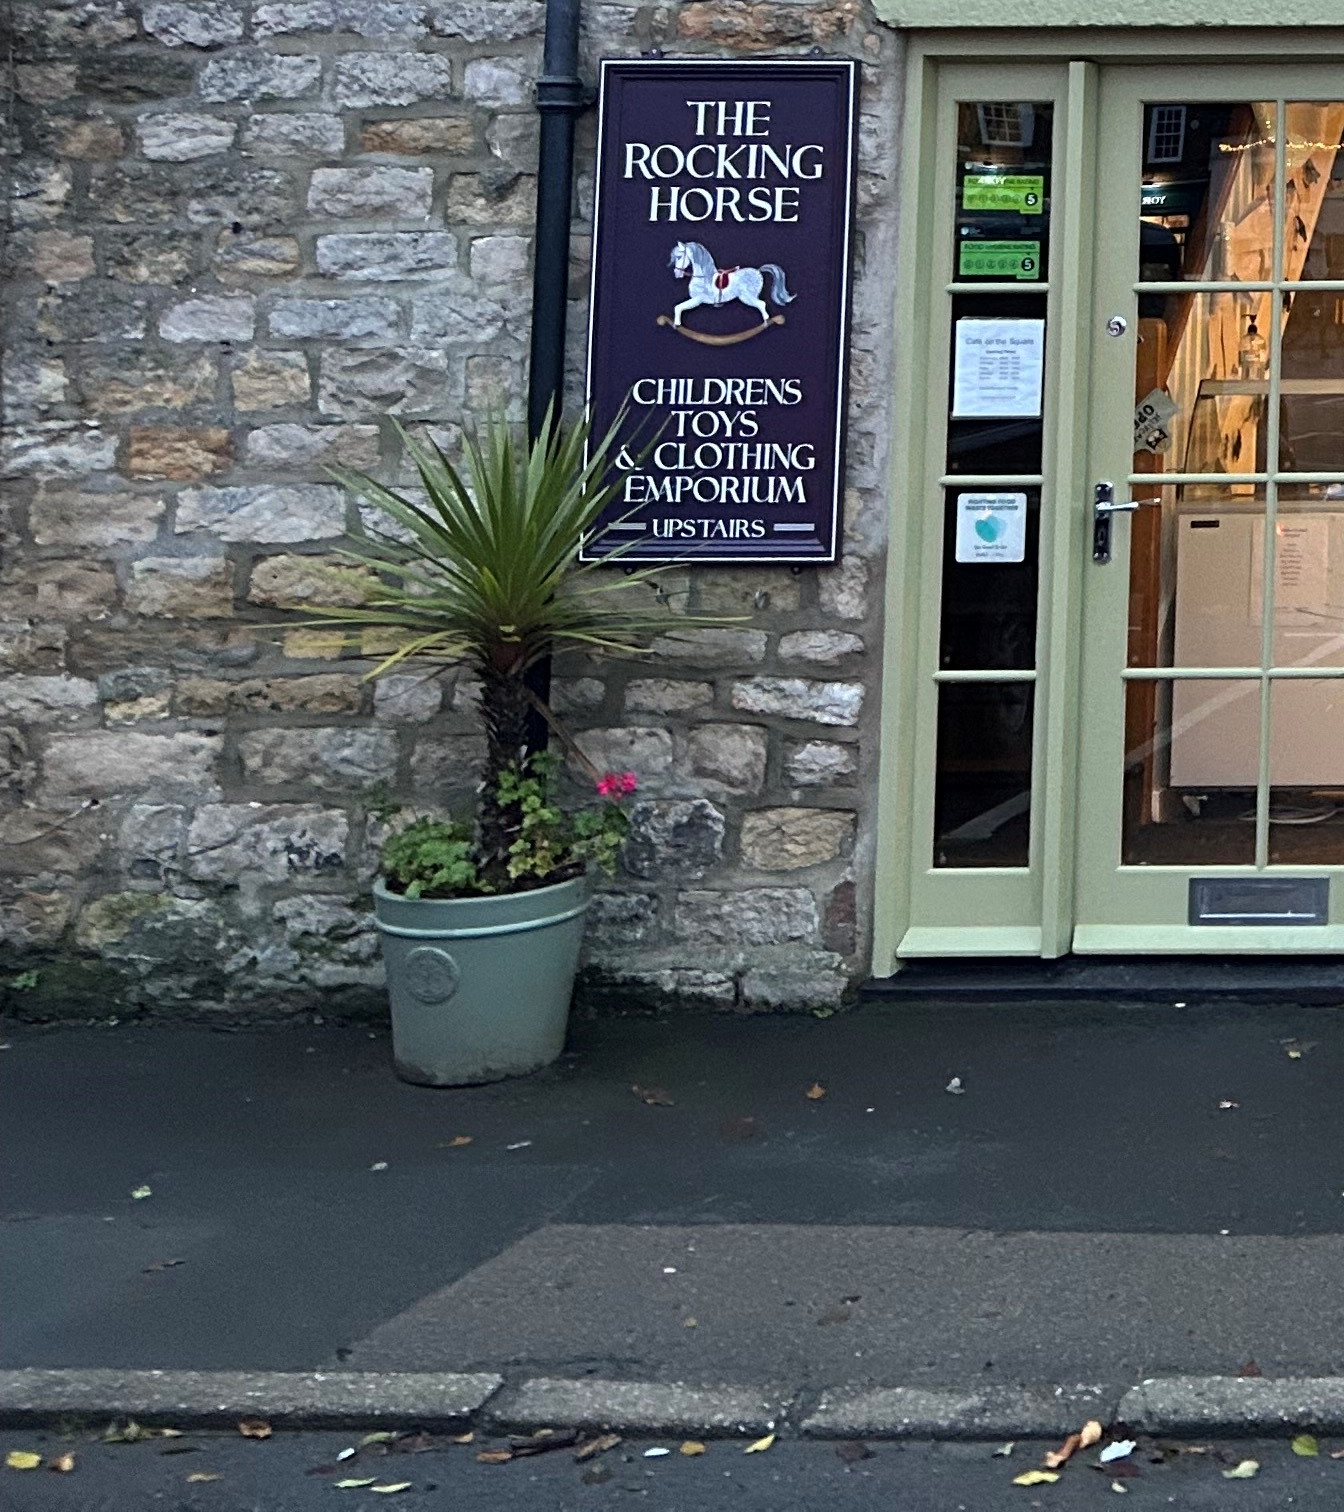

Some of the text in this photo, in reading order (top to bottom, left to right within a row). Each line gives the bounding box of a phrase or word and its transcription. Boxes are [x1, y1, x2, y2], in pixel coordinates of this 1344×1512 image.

[686, 100, 772, 137] THE
[623, 142, 825, 181] ROCKING
[648, 186, 800, 223] HORSE
[1027, 196, 1035, 204] 5
[1024, 261, 1031, 269] 5
[631, 377, 803, 406] CHILDRENS
[670, 410, 759, 438] TOYS
[653, 442, 816, 471] CLOTHING
[623, 475, 807, 504] EMPORIUM
[652, 518, 766, 538] UPSTAIRS
